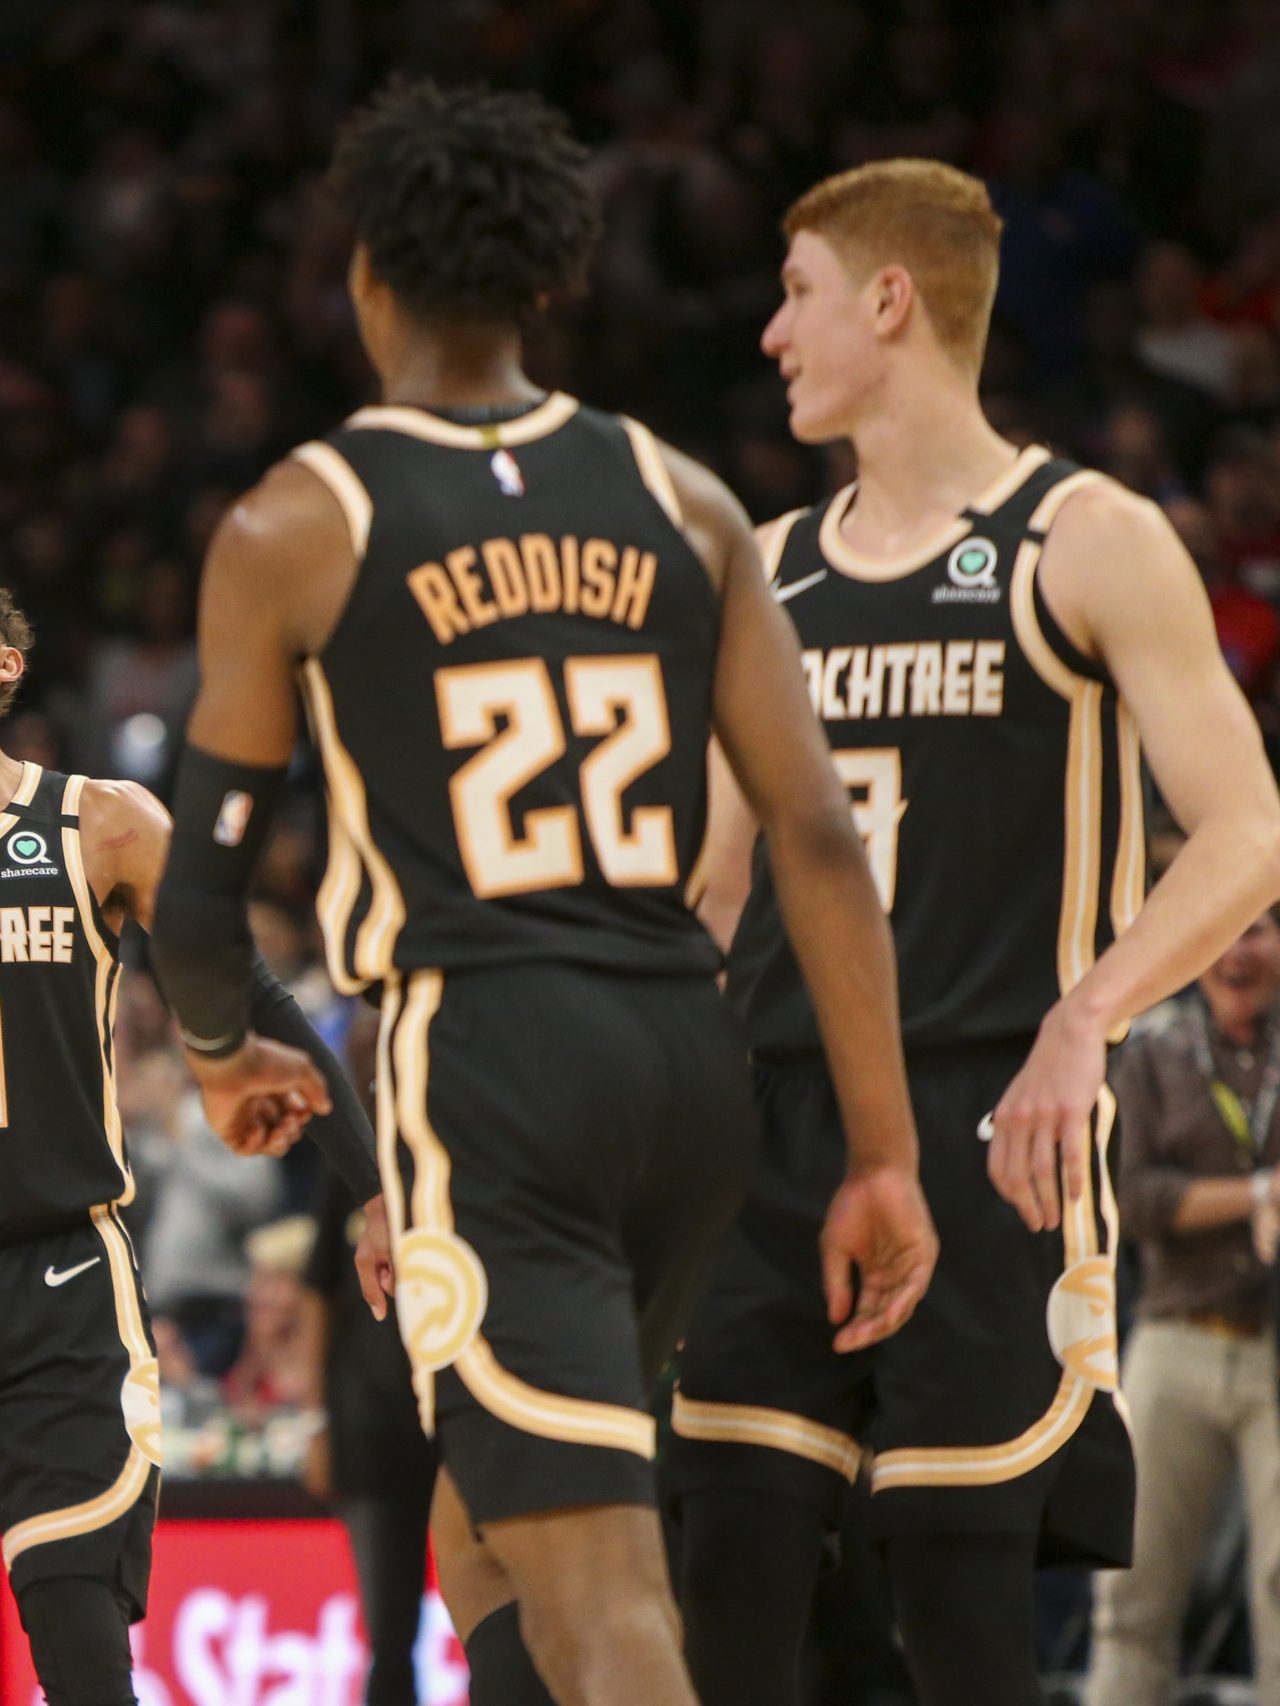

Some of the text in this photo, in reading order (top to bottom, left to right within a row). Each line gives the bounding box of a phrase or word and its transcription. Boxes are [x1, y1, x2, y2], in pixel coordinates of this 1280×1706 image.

[406, 533, 657, 645] REDDISH
[433, 653, 679, 899] 22
[0, 865, 58, 879] sharecare
